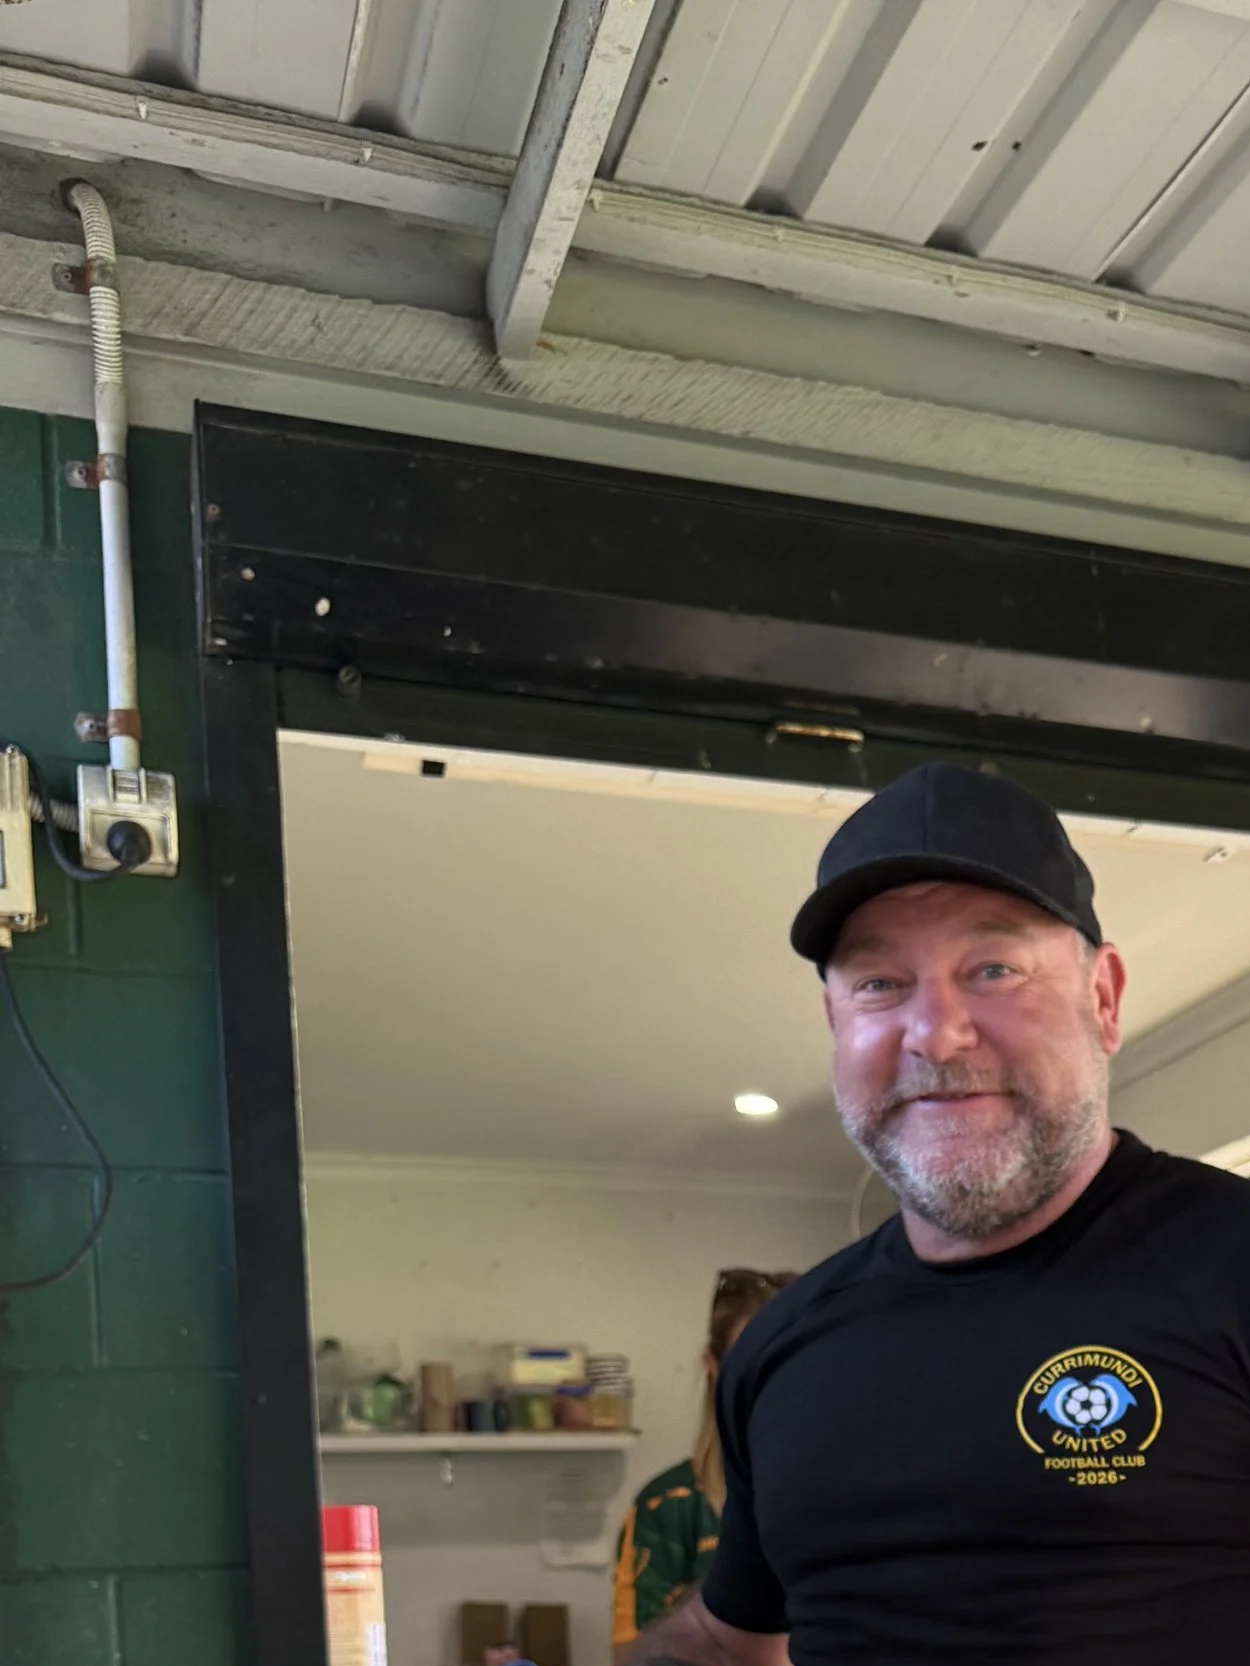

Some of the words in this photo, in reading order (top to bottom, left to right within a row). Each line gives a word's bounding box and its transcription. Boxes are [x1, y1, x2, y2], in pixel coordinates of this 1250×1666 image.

[1033, 1353, 1143, 1395] CURRIMUNDI
[1051, 1428, 1128, 1453] UNITED
[1044, 1456, 1109, 1470] FOOTBALL
[1112, 1454, 1146, 1468] CLUB
